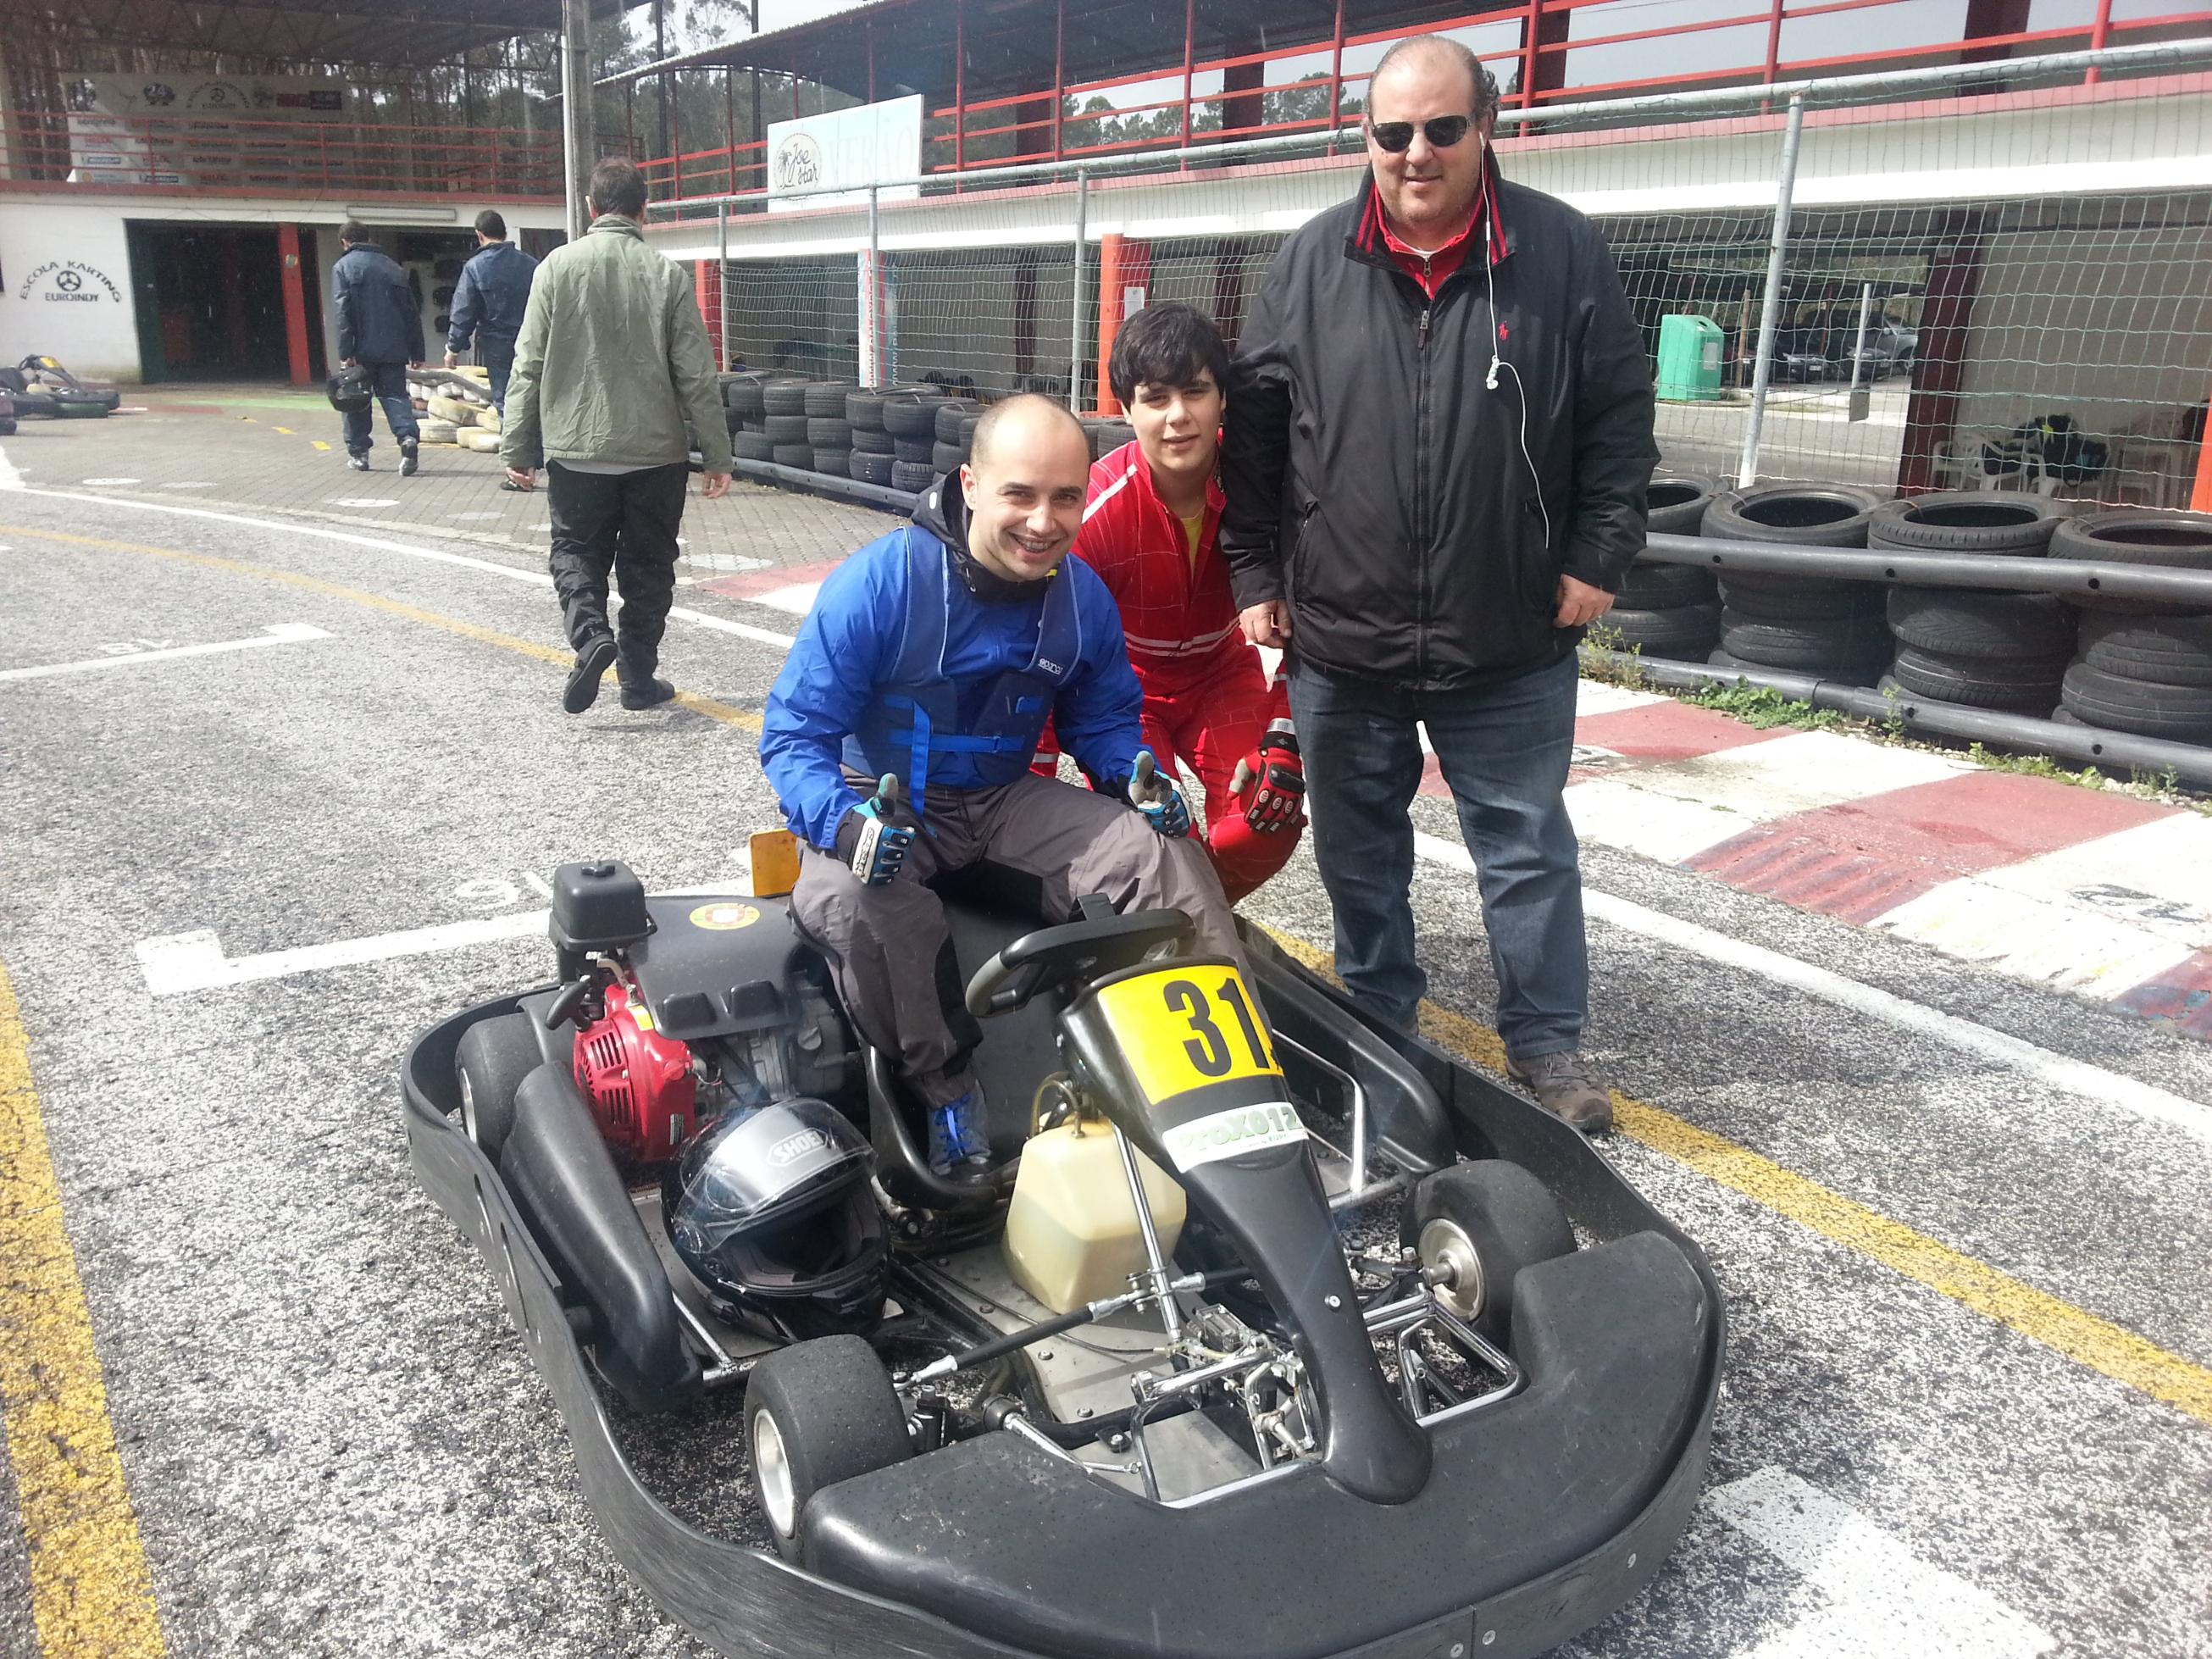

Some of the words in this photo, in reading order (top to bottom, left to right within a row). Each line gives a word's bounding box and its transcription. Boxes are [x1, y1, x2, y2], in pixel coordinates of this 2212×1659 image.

[19, 261, 59, 300] ESCOLA
[67, 260, 122, 302] KARTING
[45, 292, 100, 302] EUROINDY
[1163, 978, 1271, 1077] 31
[772, 1130, 824, 1162] SHOEI
